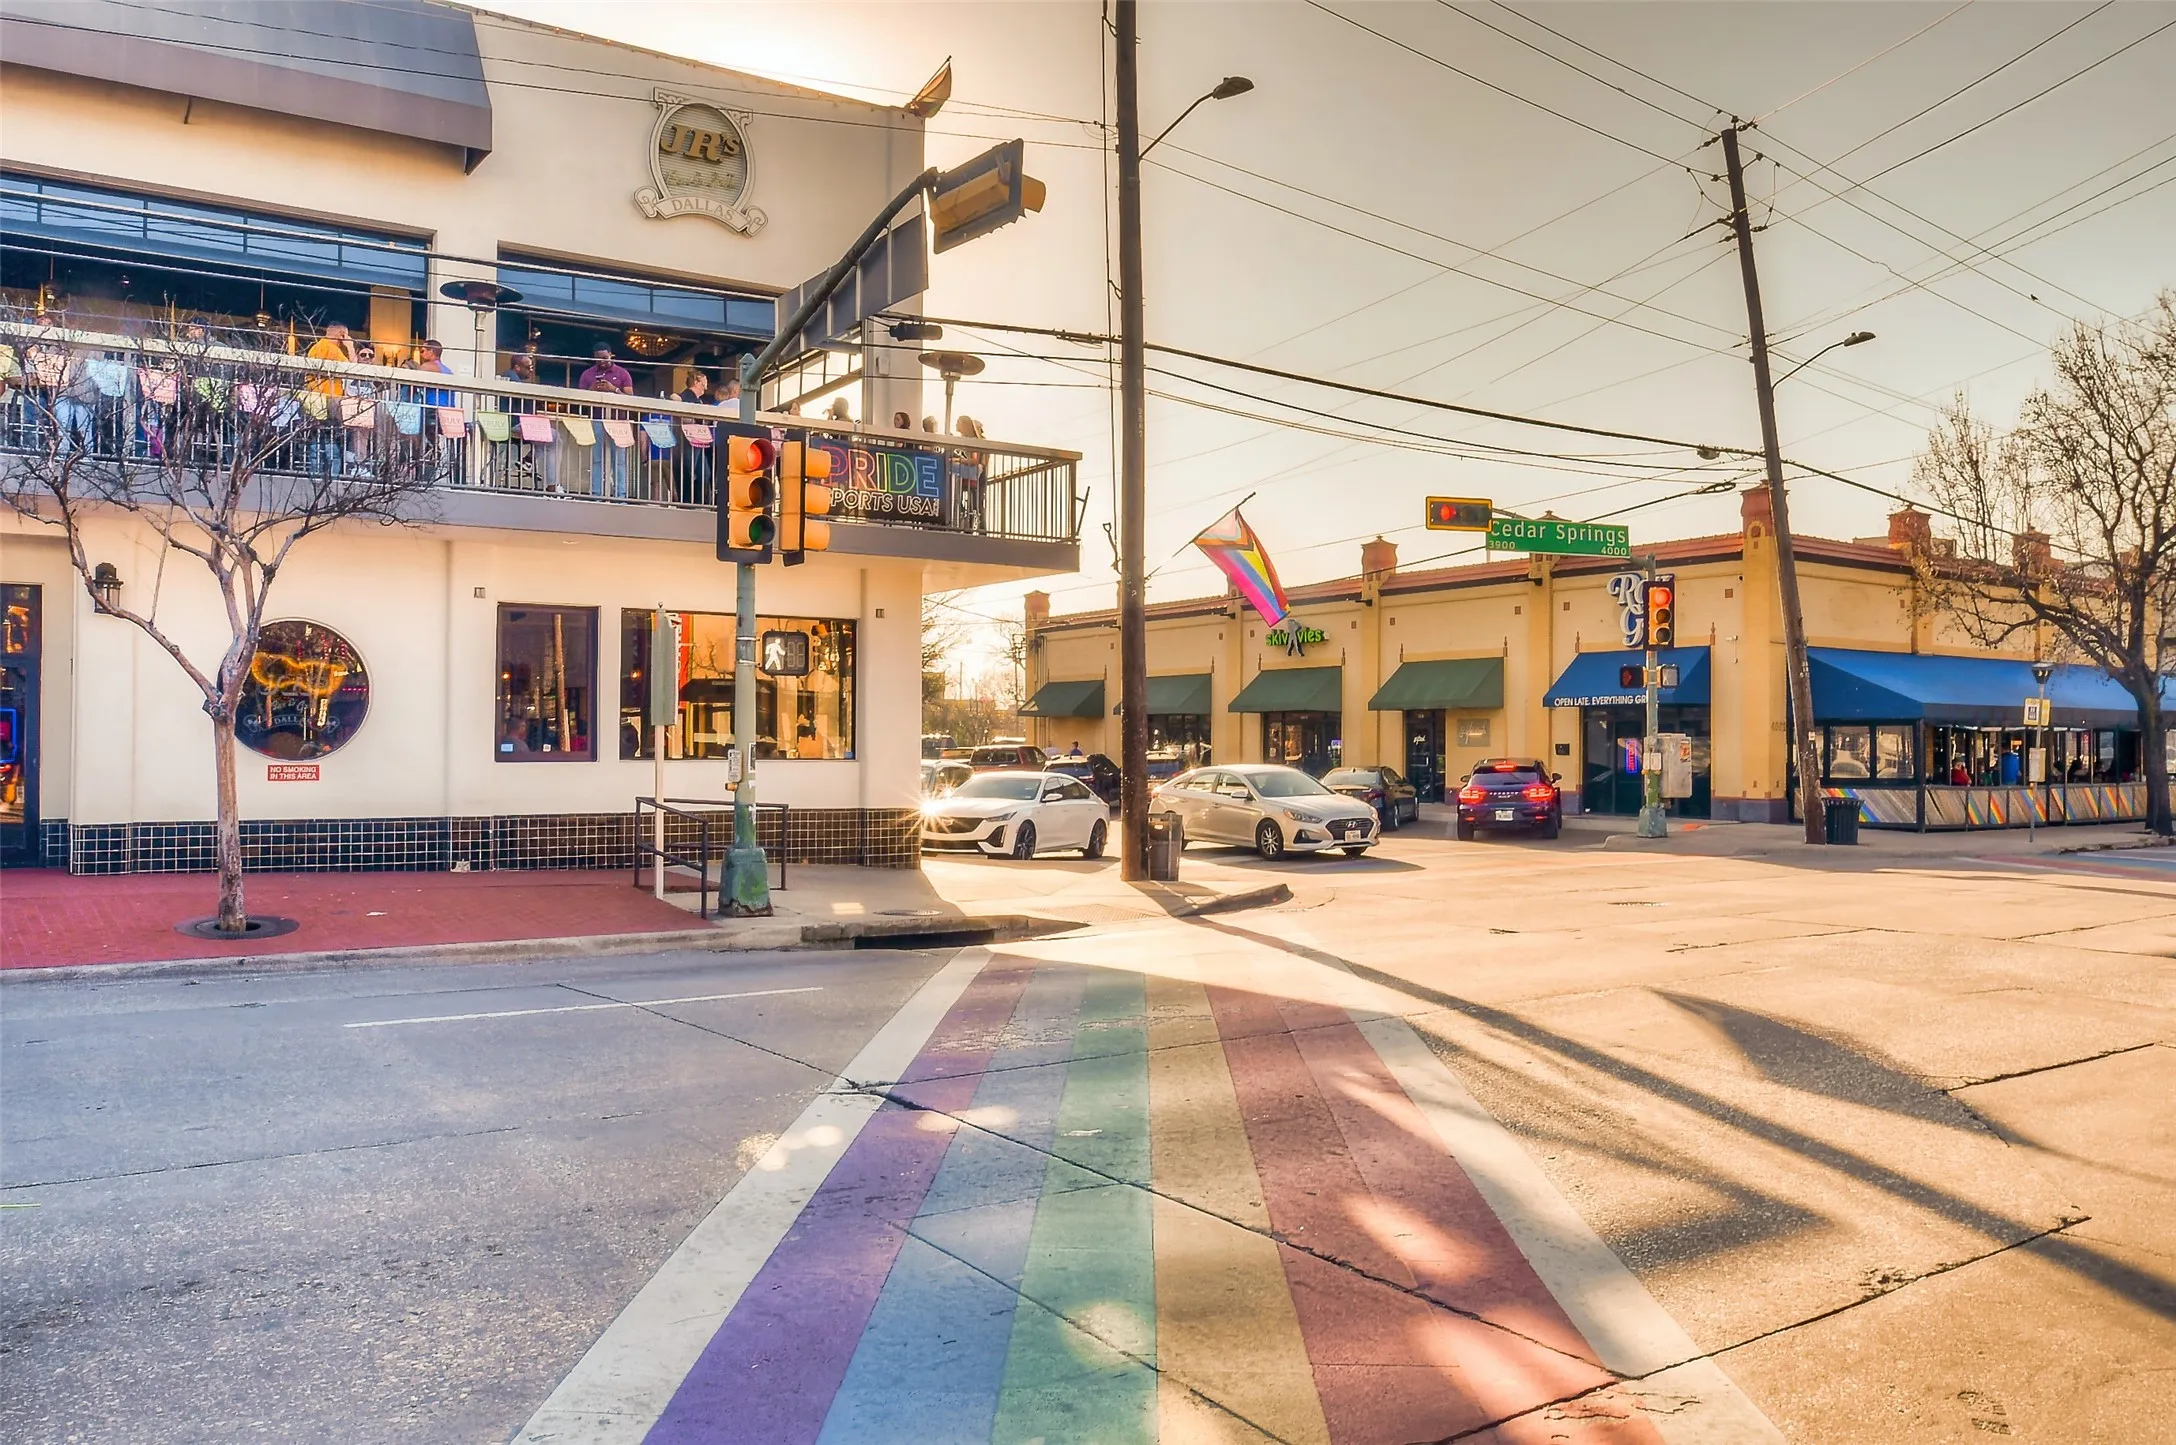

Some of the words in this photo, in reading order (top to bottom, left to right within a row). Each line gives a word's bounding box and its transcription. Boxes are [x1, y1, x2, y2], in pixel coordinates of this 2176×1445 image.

[671, 198, 735, 221] DALLAS
[821, 445, 939, 498] PRIDE
[829, 487, 893, 512] PORTS
[897, 495, 934, 517] USA
[1491, 520, 1547, 539] Cedar
[1556, 524, 1626, 547] Springs
[1489, 541, 1516, 550] 3900
[1601, 546, 1627, 556] 4000
[1554, 697, 1573, 706] OPEN
[1591, 695, 1634, 706] EVERYTHING
